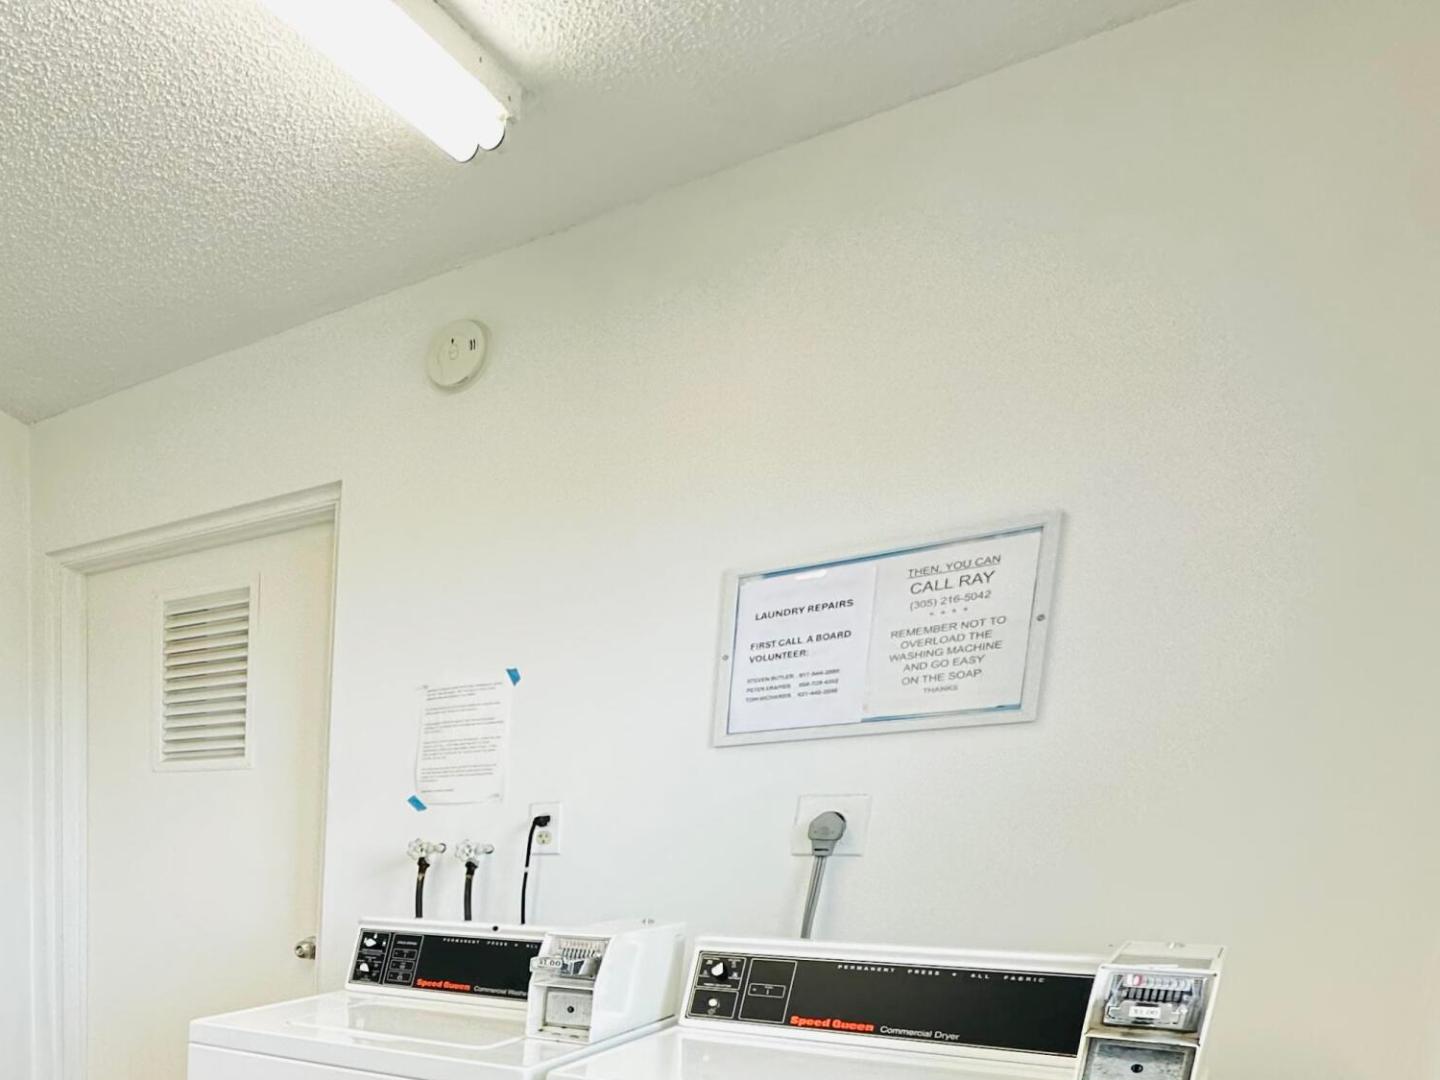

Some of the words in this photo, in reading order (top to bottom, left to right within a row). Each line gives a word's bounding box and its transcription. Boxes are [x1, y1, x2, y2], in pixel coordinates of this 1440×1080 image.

[946, 560, 972, 571] YOU
[974, 555, 1001, 567] CAN
[910, 578, 953, 595] CALL
[959, 570, 996, 588] RAY
[755, 606, 805, 621] LAUNDRY
[807, 598, 854, 613] REPAIRS
[909, 599, 937, 612] (305)
[941, 590, 992, 606] 216-5042
[890, 622, 958, 639] REMEMBER
[960, 618, 987, 630] NOT
[990, 615, 1007, 626] TO
[750, 640, 776, 651] FIRST
[778, 637, 803, 647] CALL
[806, 635, 814, 644] A
[815, 630, 852, 642] BOARD
[900, 633, 966, 650] OVERLOAD
[968, 629, 993, 640] THE
[889, 648, 944, 662] WASHING
[946, 640, 1003, 655] MACHINE
[903, 661, 928, 672] AND
[930, 659, 950, 669] GO
[952, 654, 985, 666] EASY
[901, 676, 920, 686] ON
[922, 673, 945, 683] THE
[948, 668, 982, 681] SOAP
[837, 964, 895, 973] PERMANENT
[1003, 975, 1046, 983] FABRIC
[416, 977, 443, 989] Speed
[443, 980, 471, 992] Queen
[473, 985, 507, 995] Commercial
[790, 1015, 831, 1029] Speed
[832, 1020, 875, 1033] Queen
[880, 1025, 932, 1038] Commercial
[934, 1031, 960, 1042] Dryer
